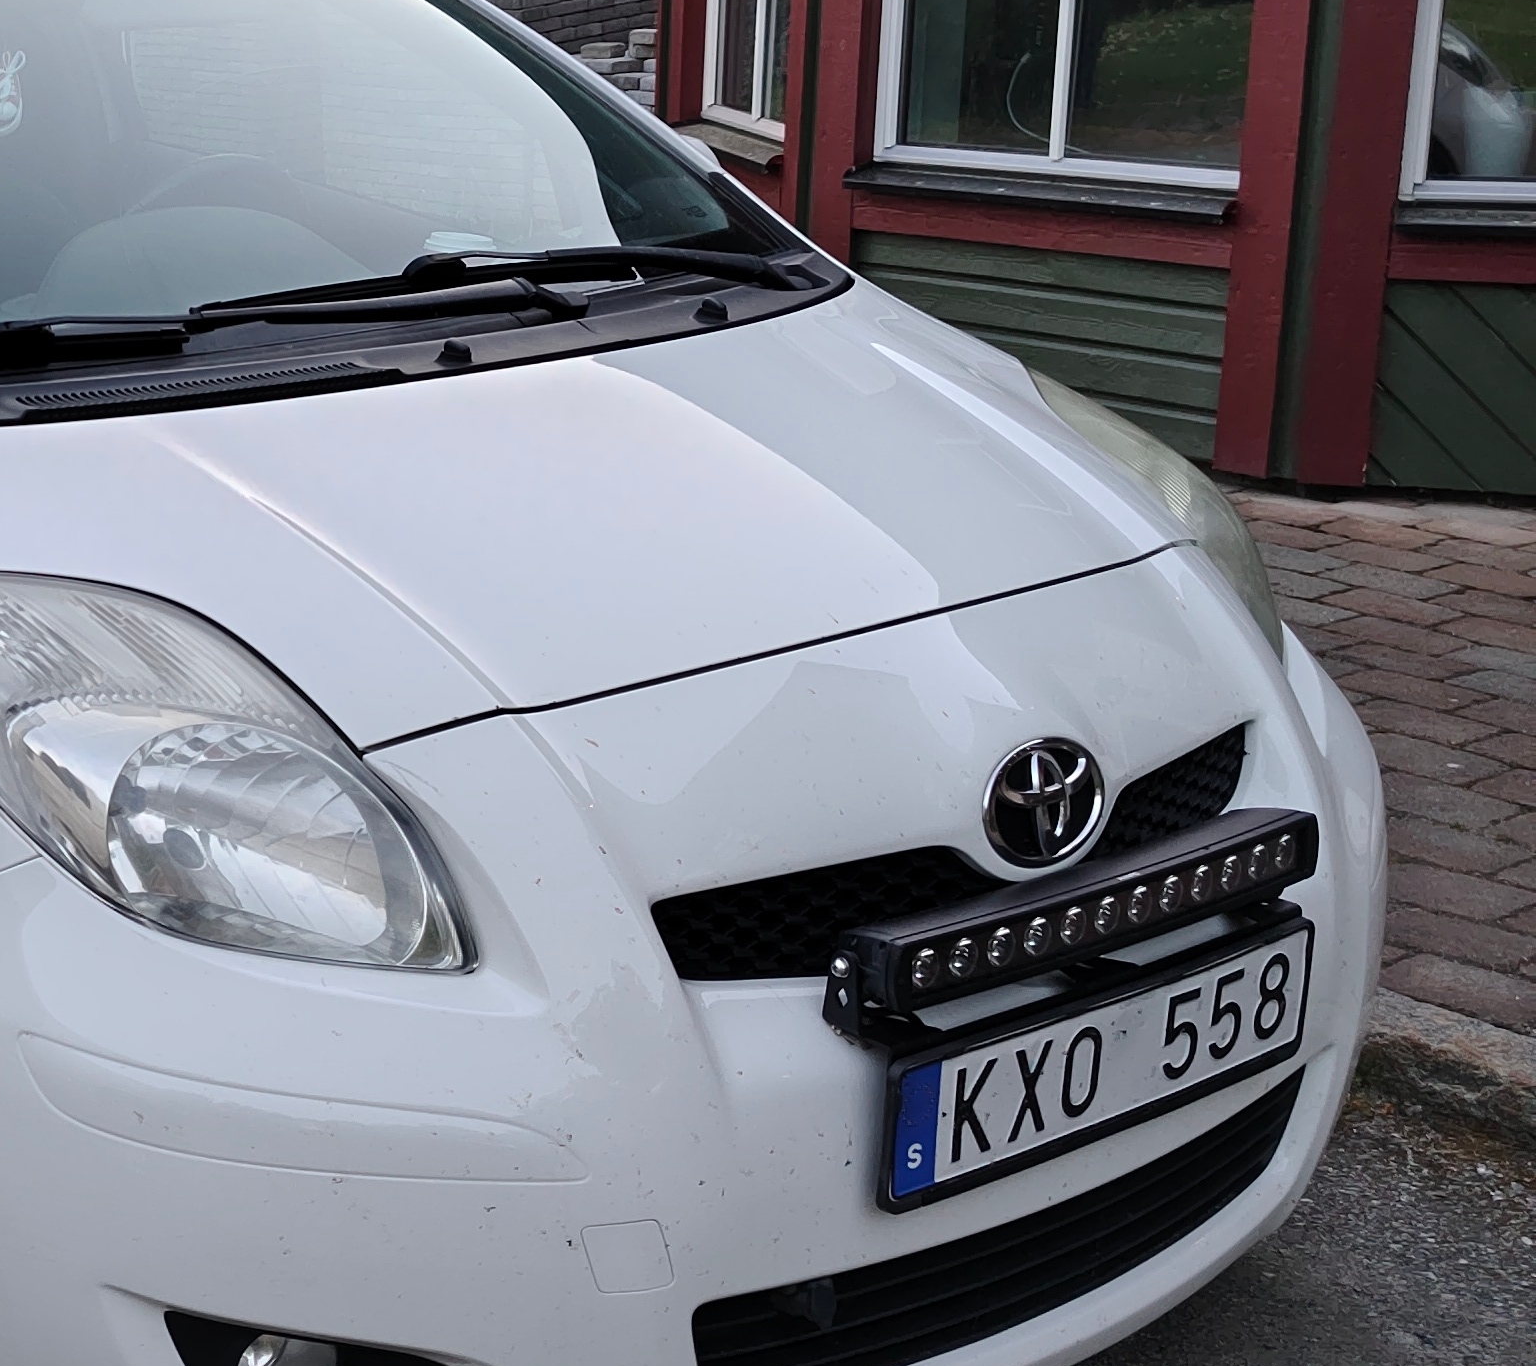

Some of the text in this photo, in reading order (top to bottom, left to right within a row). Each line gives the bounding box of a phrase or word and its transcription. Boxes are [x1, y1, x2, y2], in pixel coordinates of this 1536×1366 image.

[950, 952, 1290, 1164] KXO 558
[906, 1142, 923, 1170] S
